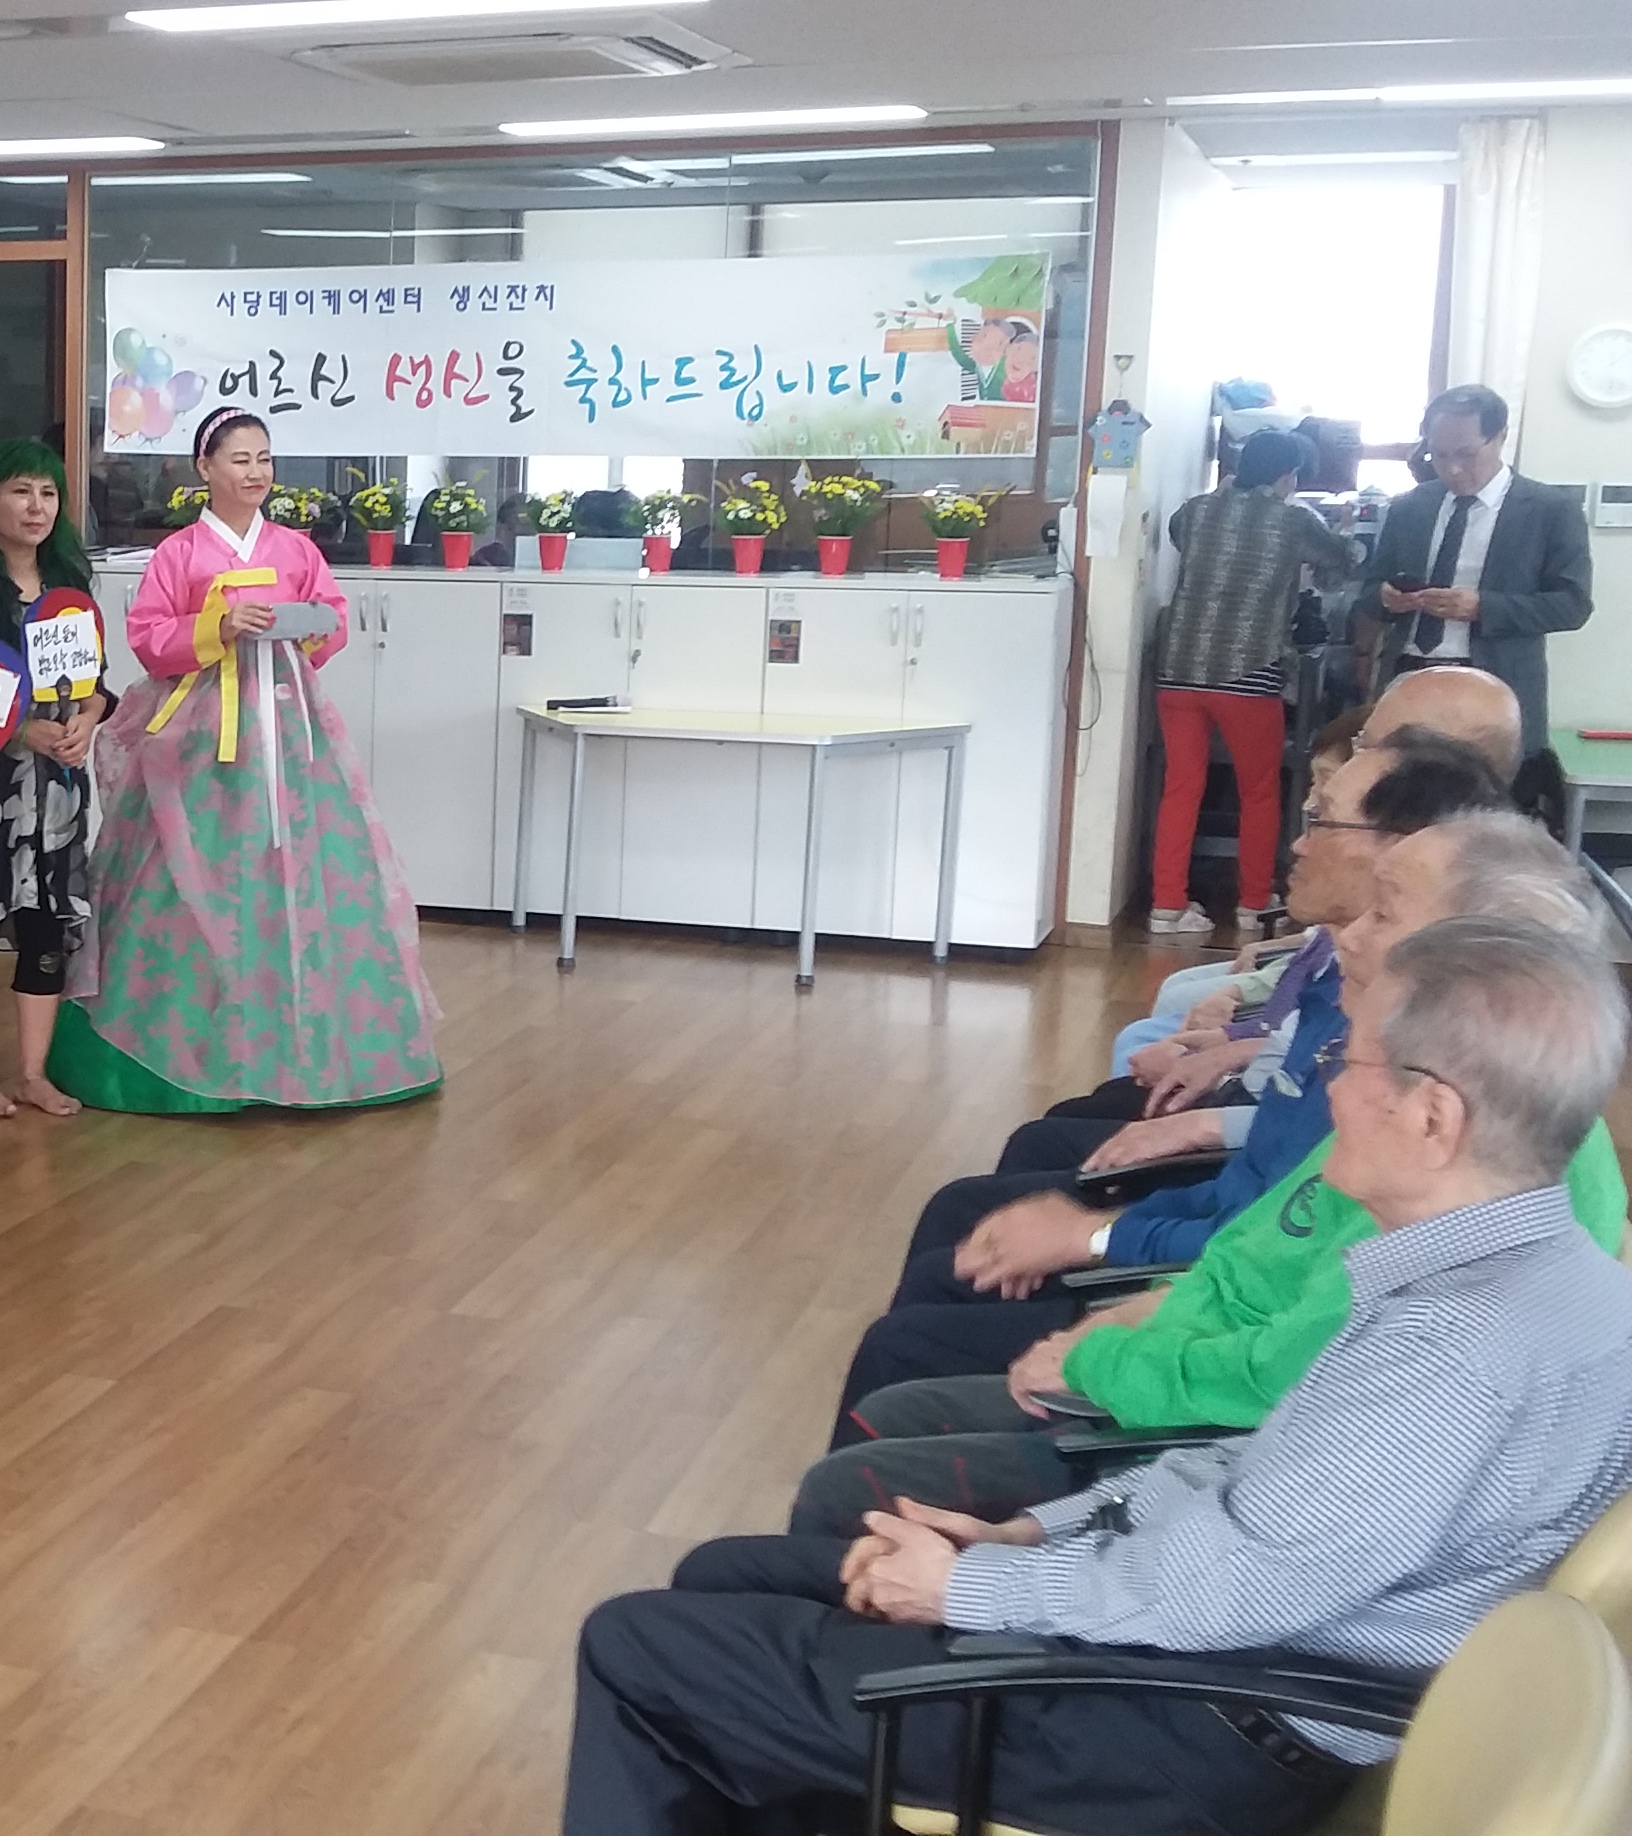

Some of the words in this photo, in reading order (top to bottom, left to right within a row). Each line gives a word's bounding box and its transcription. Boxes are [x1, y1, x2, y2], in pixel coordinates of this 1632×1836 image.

[216, 286, 423, 318] 사당데이케어센터
[449, 283, 556, 313] 생신잔치
[218, 348, 356, 415] 어르신
[384, 340, 536, 424] 생신을
[563, 337, 908, 423] 축하드립니다!
